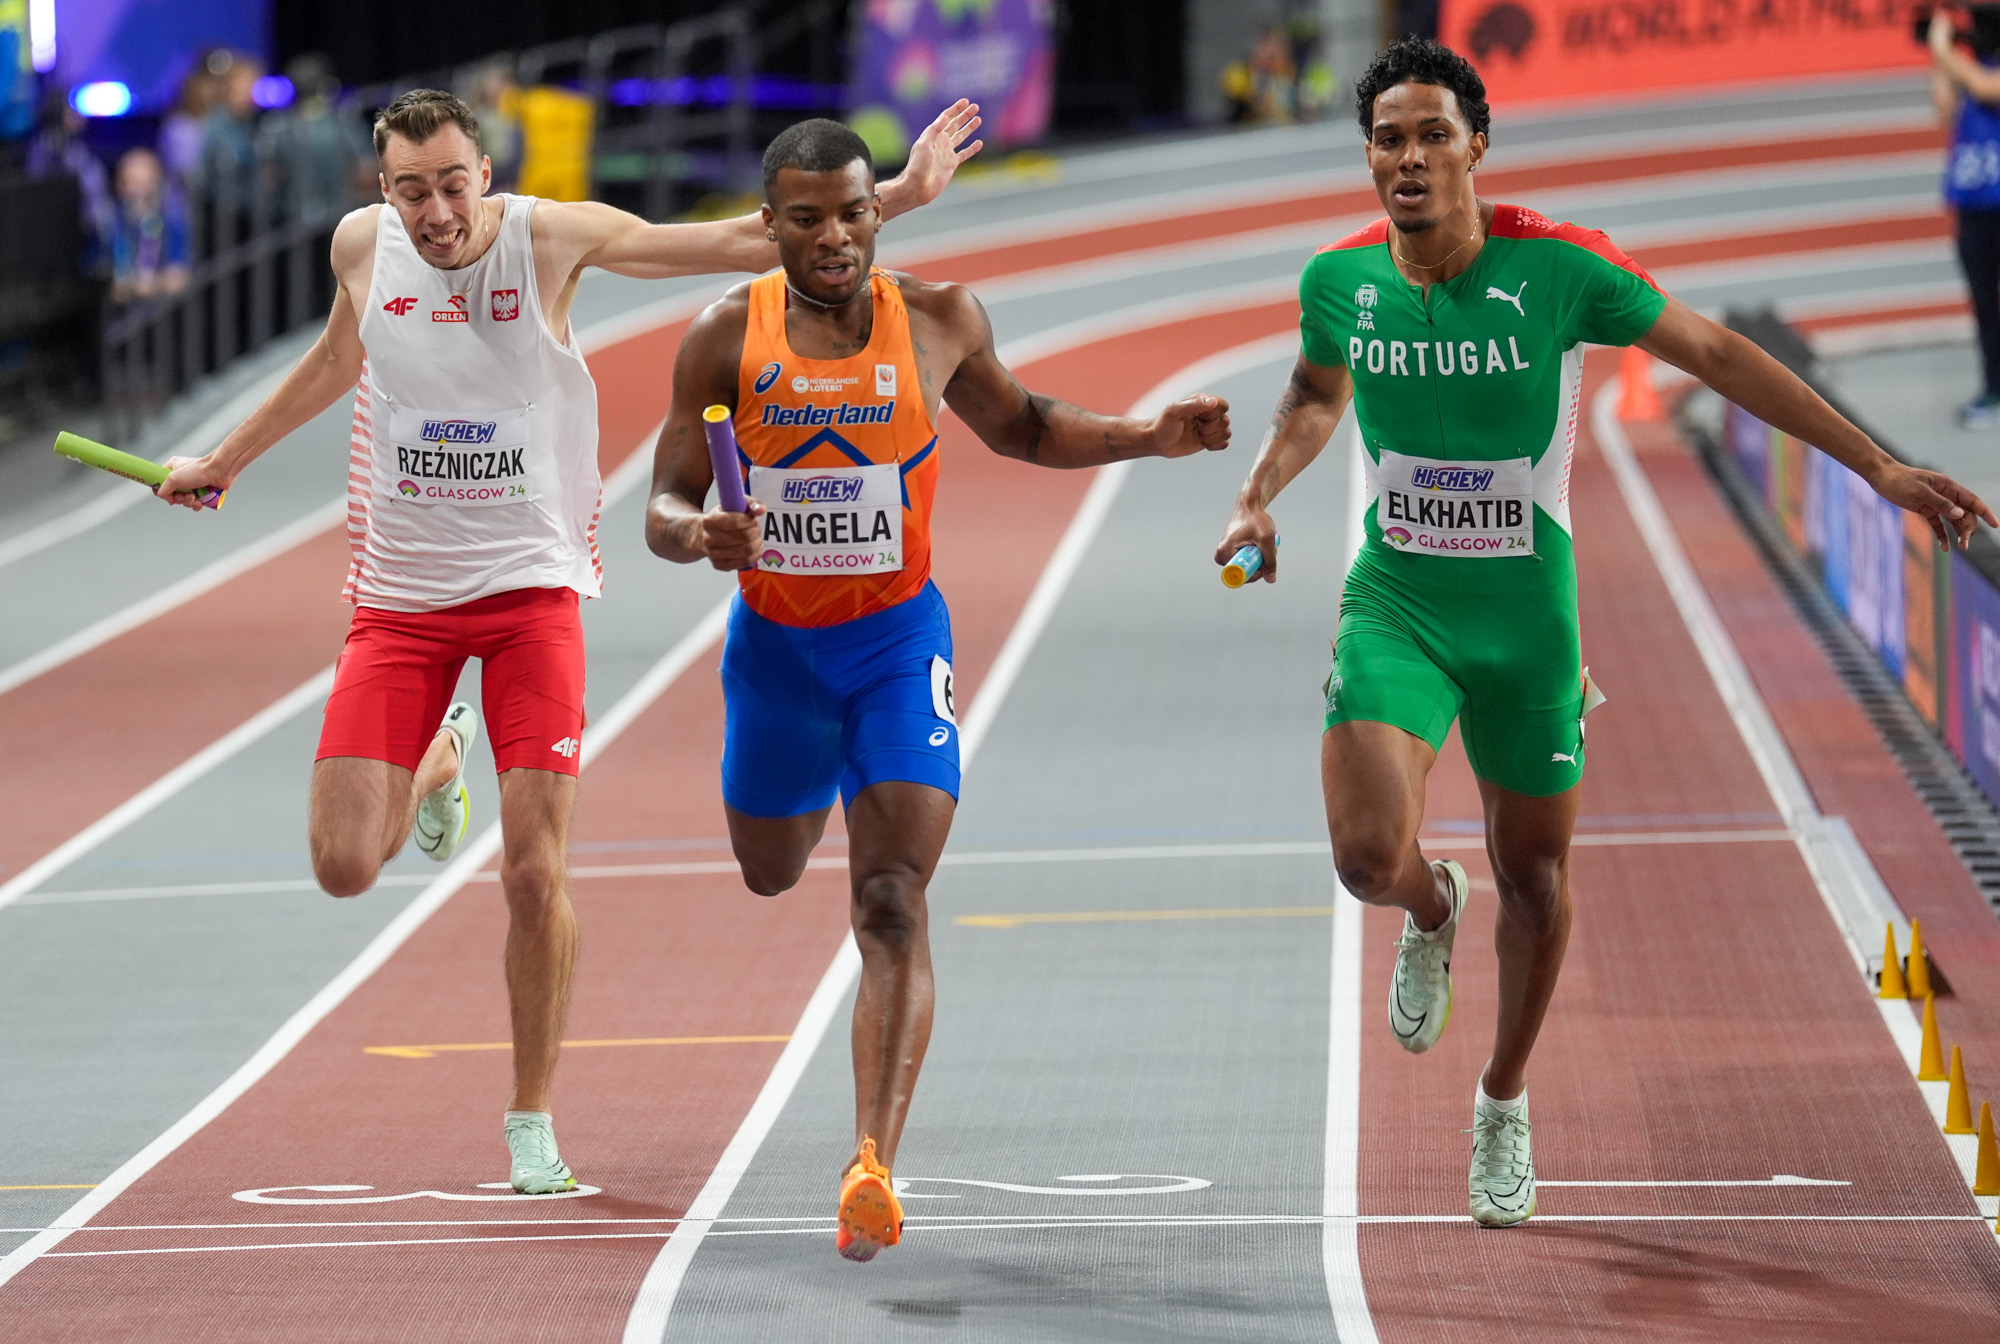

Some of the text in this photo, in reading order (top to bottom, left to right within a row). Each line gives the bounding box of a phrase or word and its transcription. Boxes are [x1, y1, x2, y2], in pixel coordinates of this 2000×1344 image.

[383, 297, 418, 316] 4F
[433, 312, 467, 321] ORLEN
[1357, 319, 1375, 331] FPA
[1349, 336, 1530, 377] PORTUGAL
[809, 377, 859, 385] NEDERLANDSE
[420, 420, 496, 444] HI-CHEW
[397, 445, 525, 481] RZEŹNICZAK
[1411, 465, 1494, 491] HI-CHEW
[426, 484, 526, 500] GLASGOW 24
[781, 476, 863, 502] HI-CHEW
[1388, 490, 1523, 529] ELKHATIB
[763, 510, 892, 545] ANGELA
[1418, 534, 1527, 550] GLASGOW 24
[790, 551, 896, 568] GLASGOW 24
